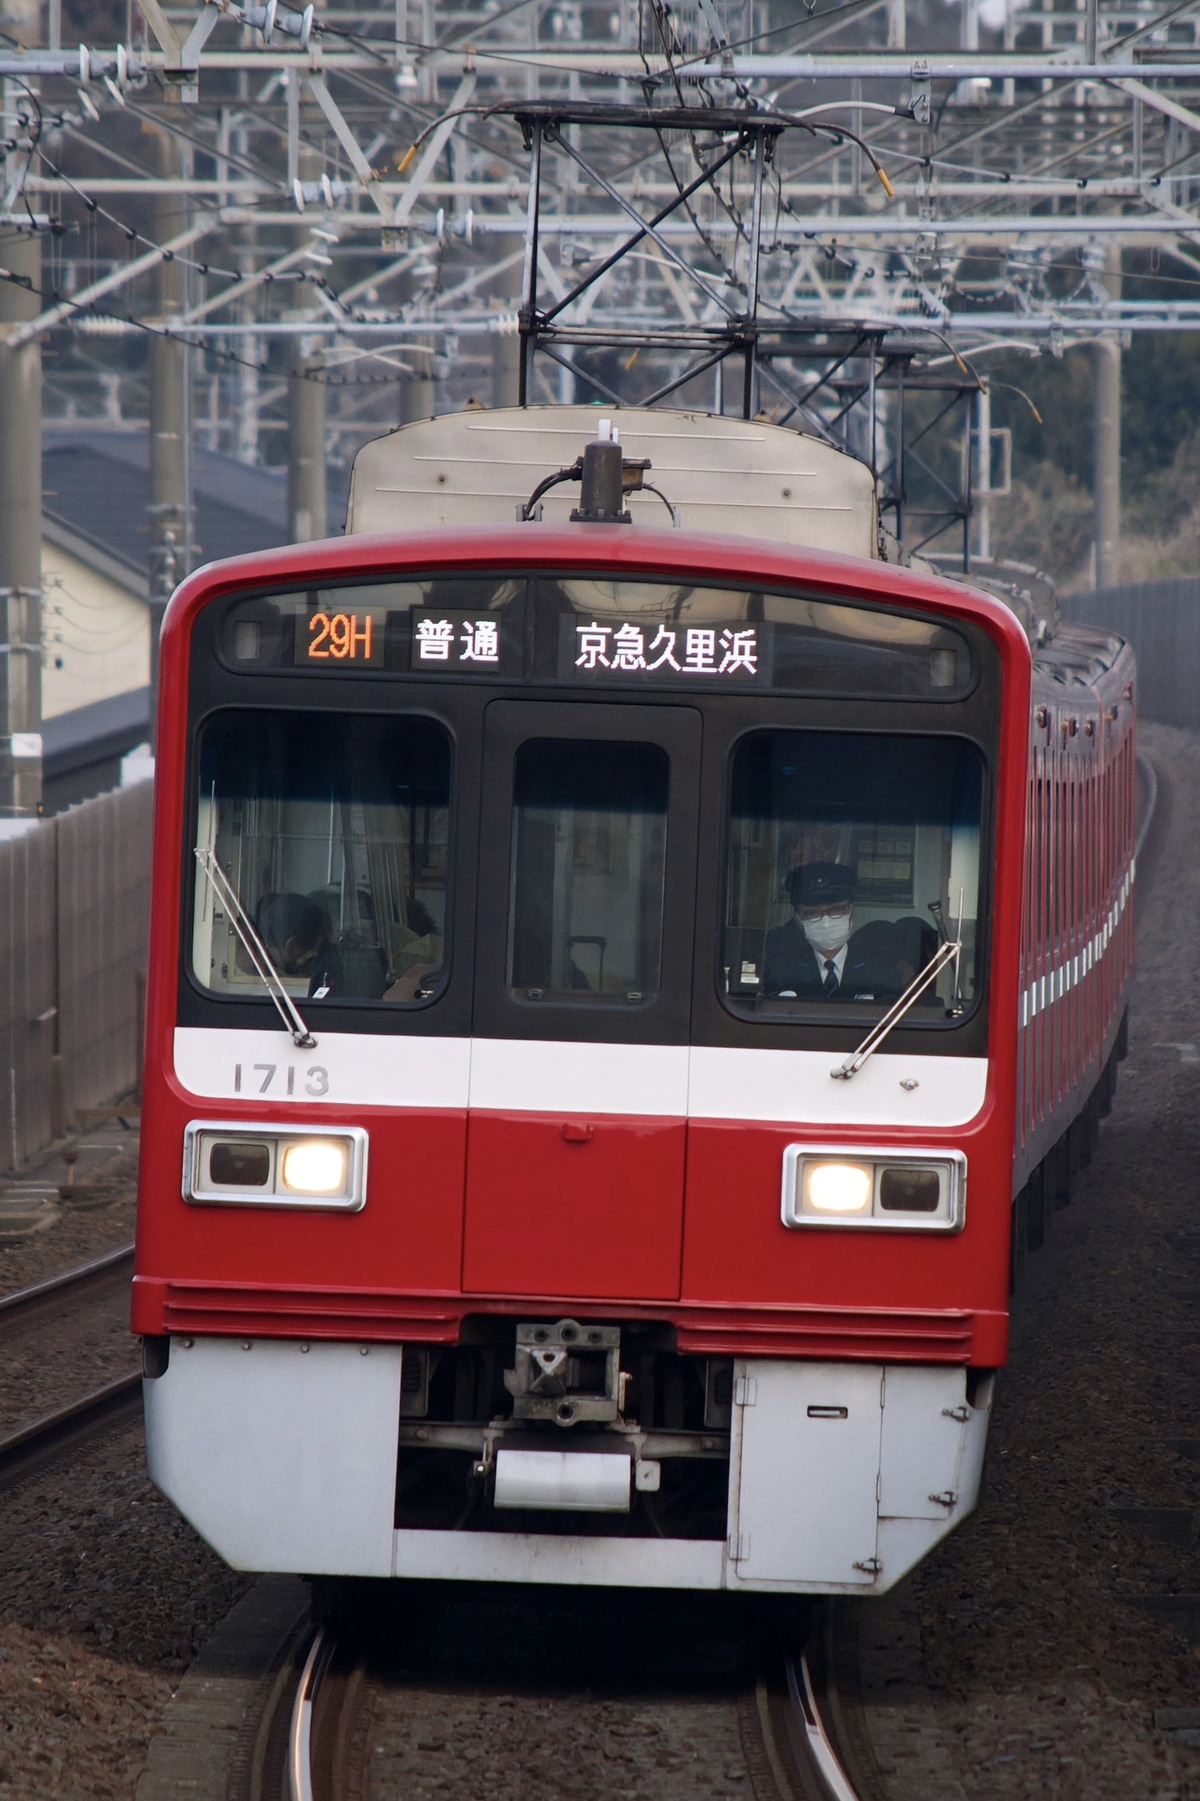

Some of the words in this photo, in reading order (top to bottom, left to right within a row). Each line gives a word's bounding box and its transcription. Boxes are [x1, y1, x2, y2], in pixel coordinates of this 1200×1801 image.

[308, 613, 373, 659] 29H
[415, 619, 499, 662] 普通
[575, 622, 758, 675] 京急久里浜
[234, 1063, 329, 1096] 1713
